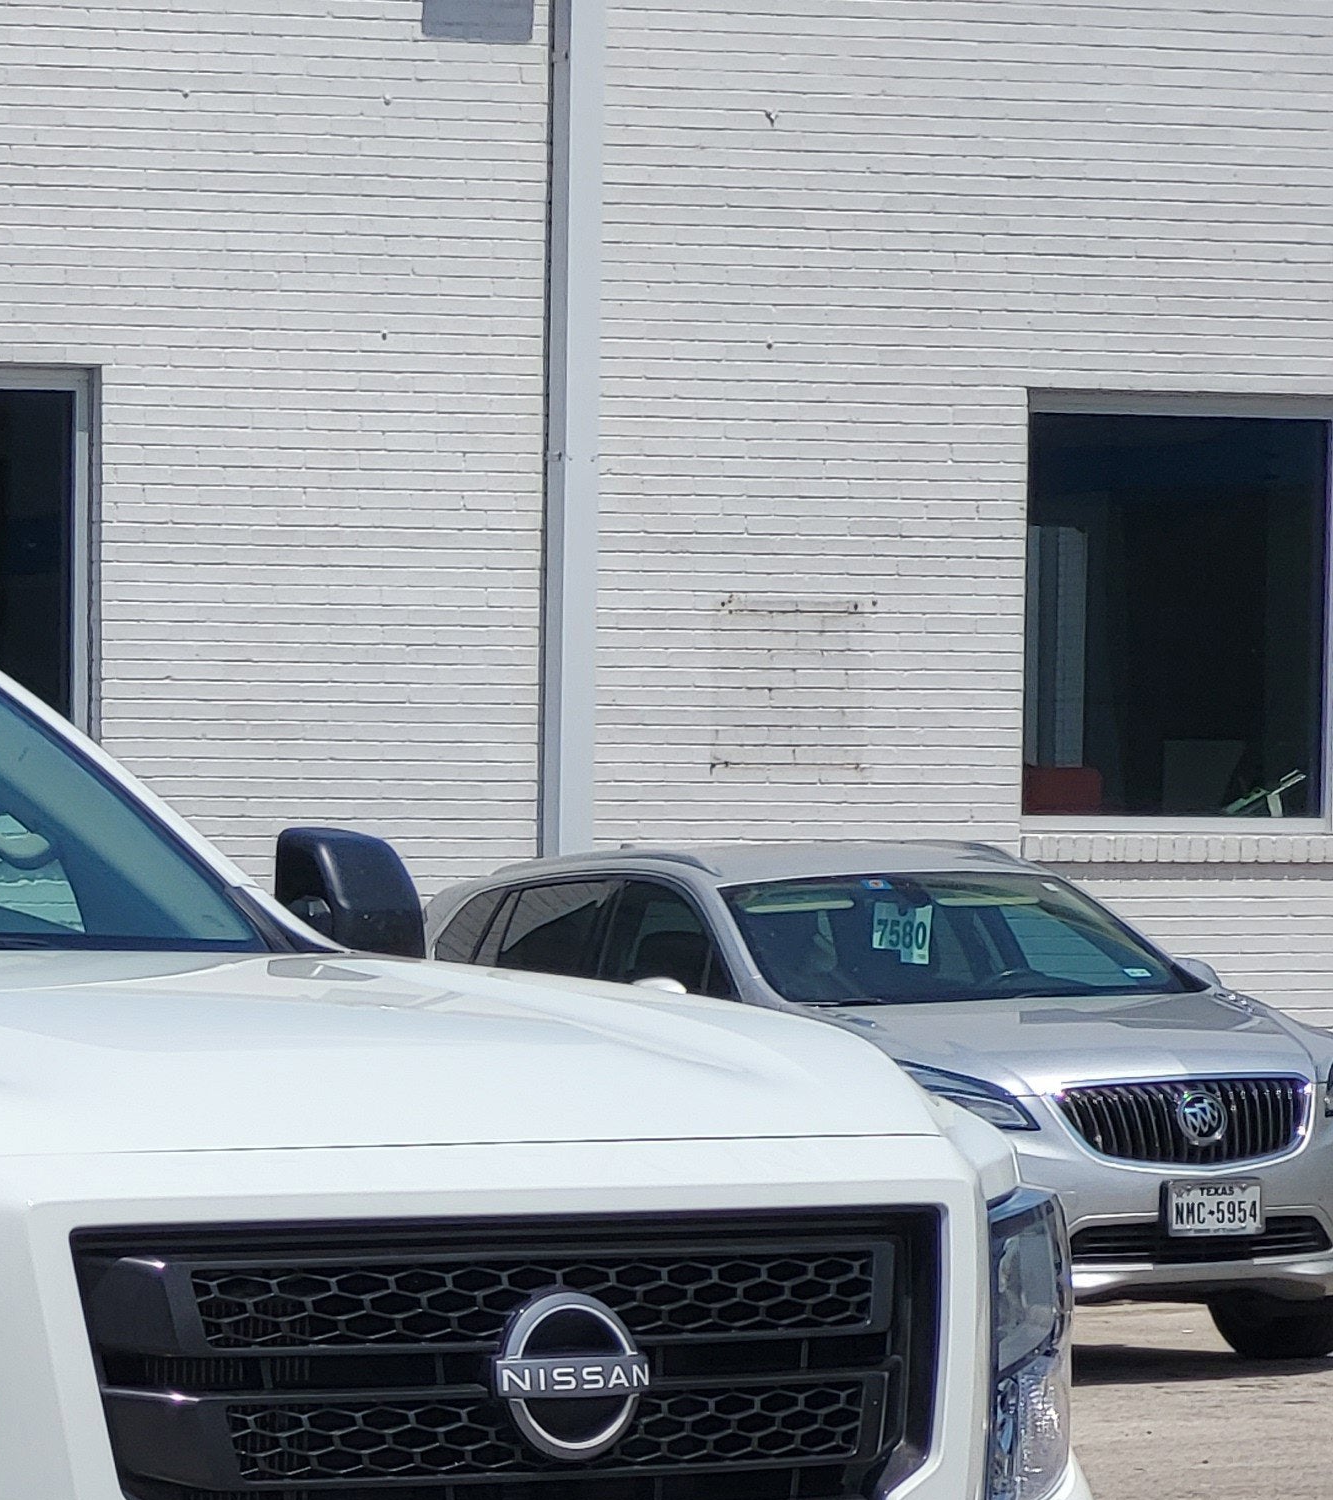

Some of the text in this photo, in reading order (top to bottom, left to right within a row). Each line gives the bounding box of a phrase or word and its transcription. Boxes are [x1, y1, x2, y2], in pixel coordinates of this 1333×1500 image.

[877, 919, 927, 949] 7580
[1199, 1187, 1235, 1197] TEXAS
[502, 1363, 650, 1392] NISSAN
